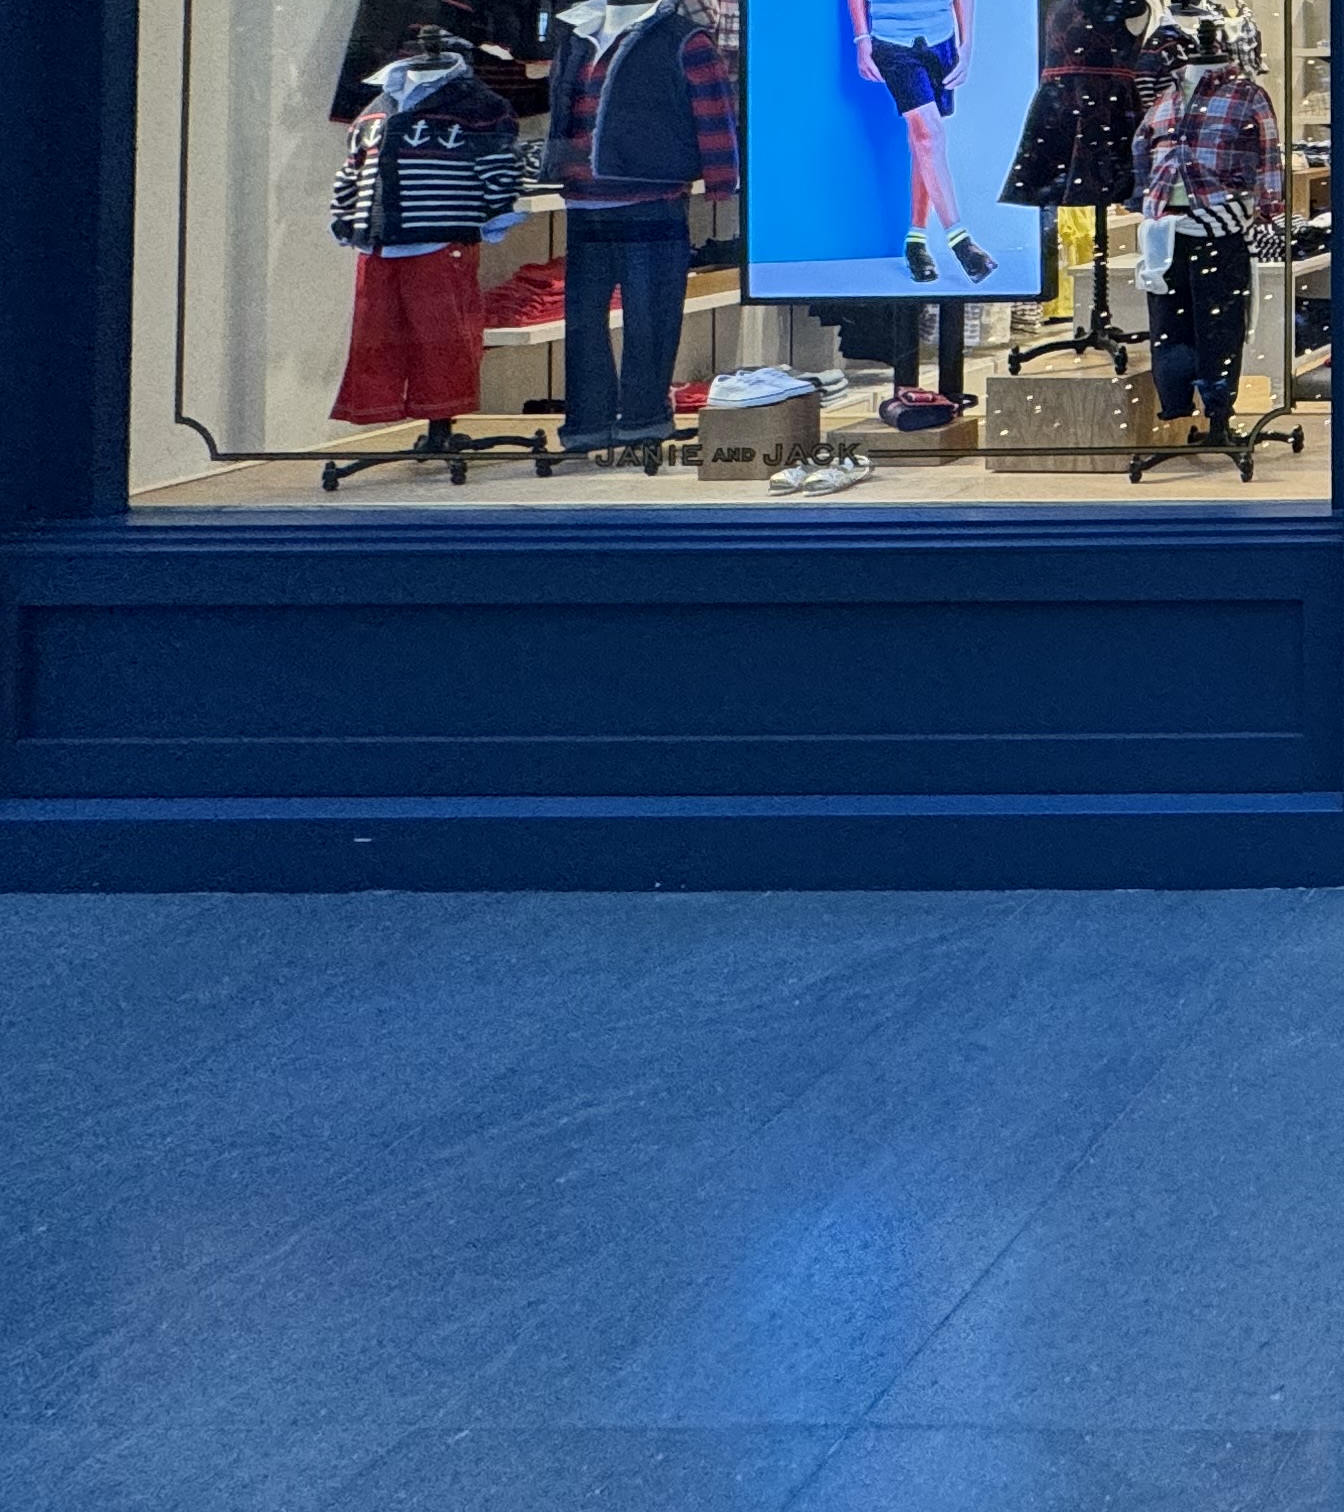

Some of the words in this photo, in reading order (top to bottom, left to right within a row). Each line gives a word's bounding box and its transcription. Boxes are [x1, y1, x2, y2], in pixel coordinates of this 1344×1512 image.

[595, 443, 704, 468] JANIE
[711, 447, 756, 463] AND
[763, 442, 860, 467] JACK
